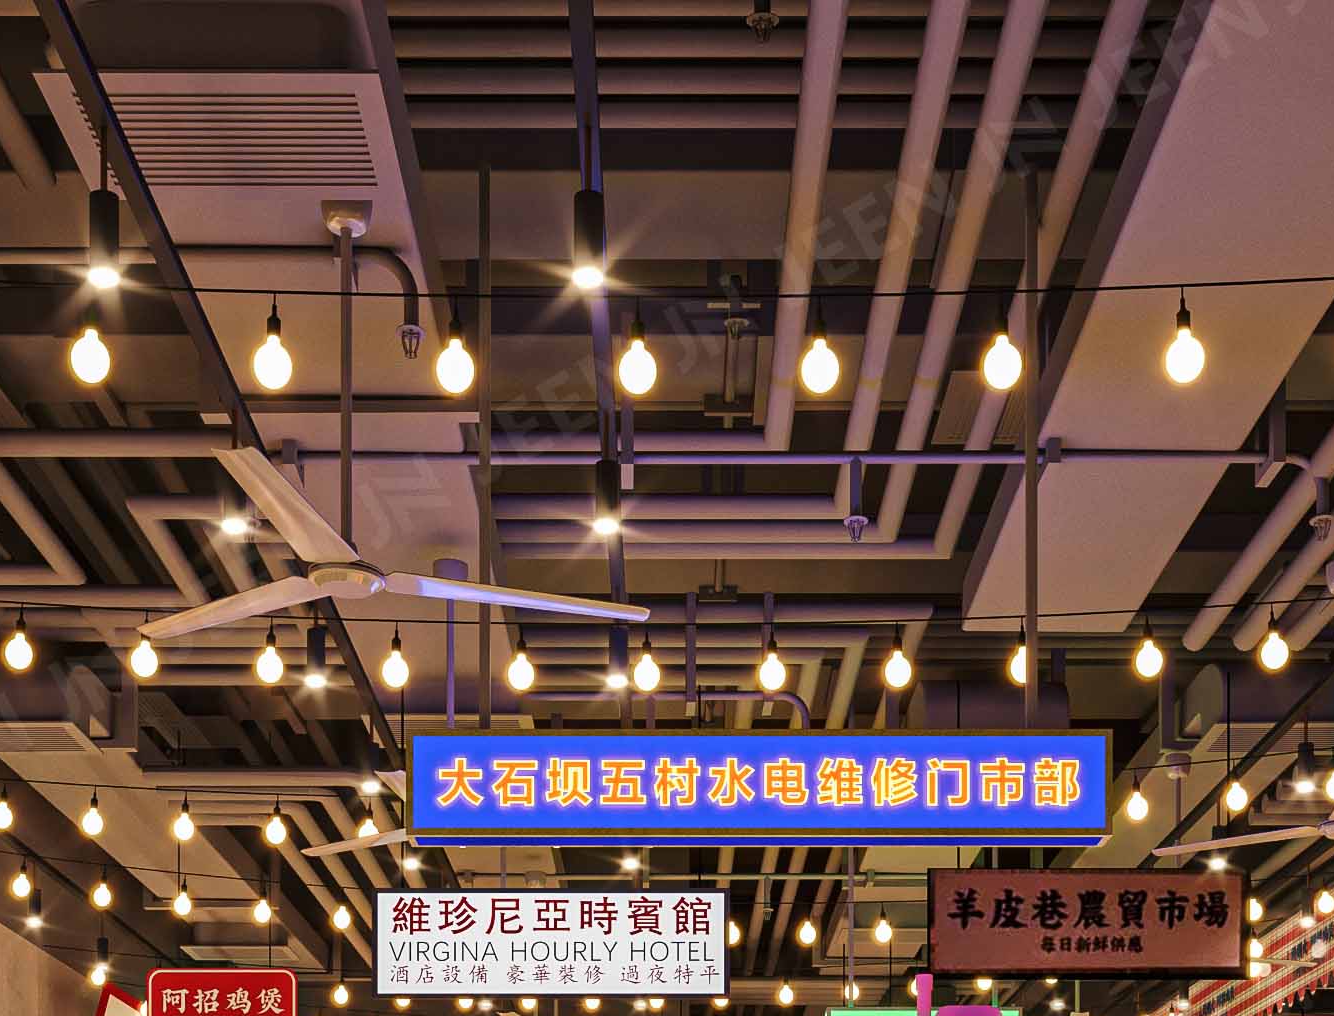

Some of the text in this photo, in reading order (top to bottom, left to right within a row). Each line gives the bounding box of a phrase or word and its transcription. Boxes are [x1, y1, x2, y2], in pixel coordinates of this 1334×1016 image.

[436, 756, 1082, 809] 大石坝五村水电维修门市部
[391, 895, 713, 936] 維珍尼亞時賓館
[947, 887, 1230, 930] 羊皮巷農貿市場
[389, 941, 715, 962] VIRGINA HOURLY HOTEL
[390, 965, 721, 985] 酒店設備 豪華裝修 過夜特平
[160, 986, 286, 1015] 阿招鸡煲
